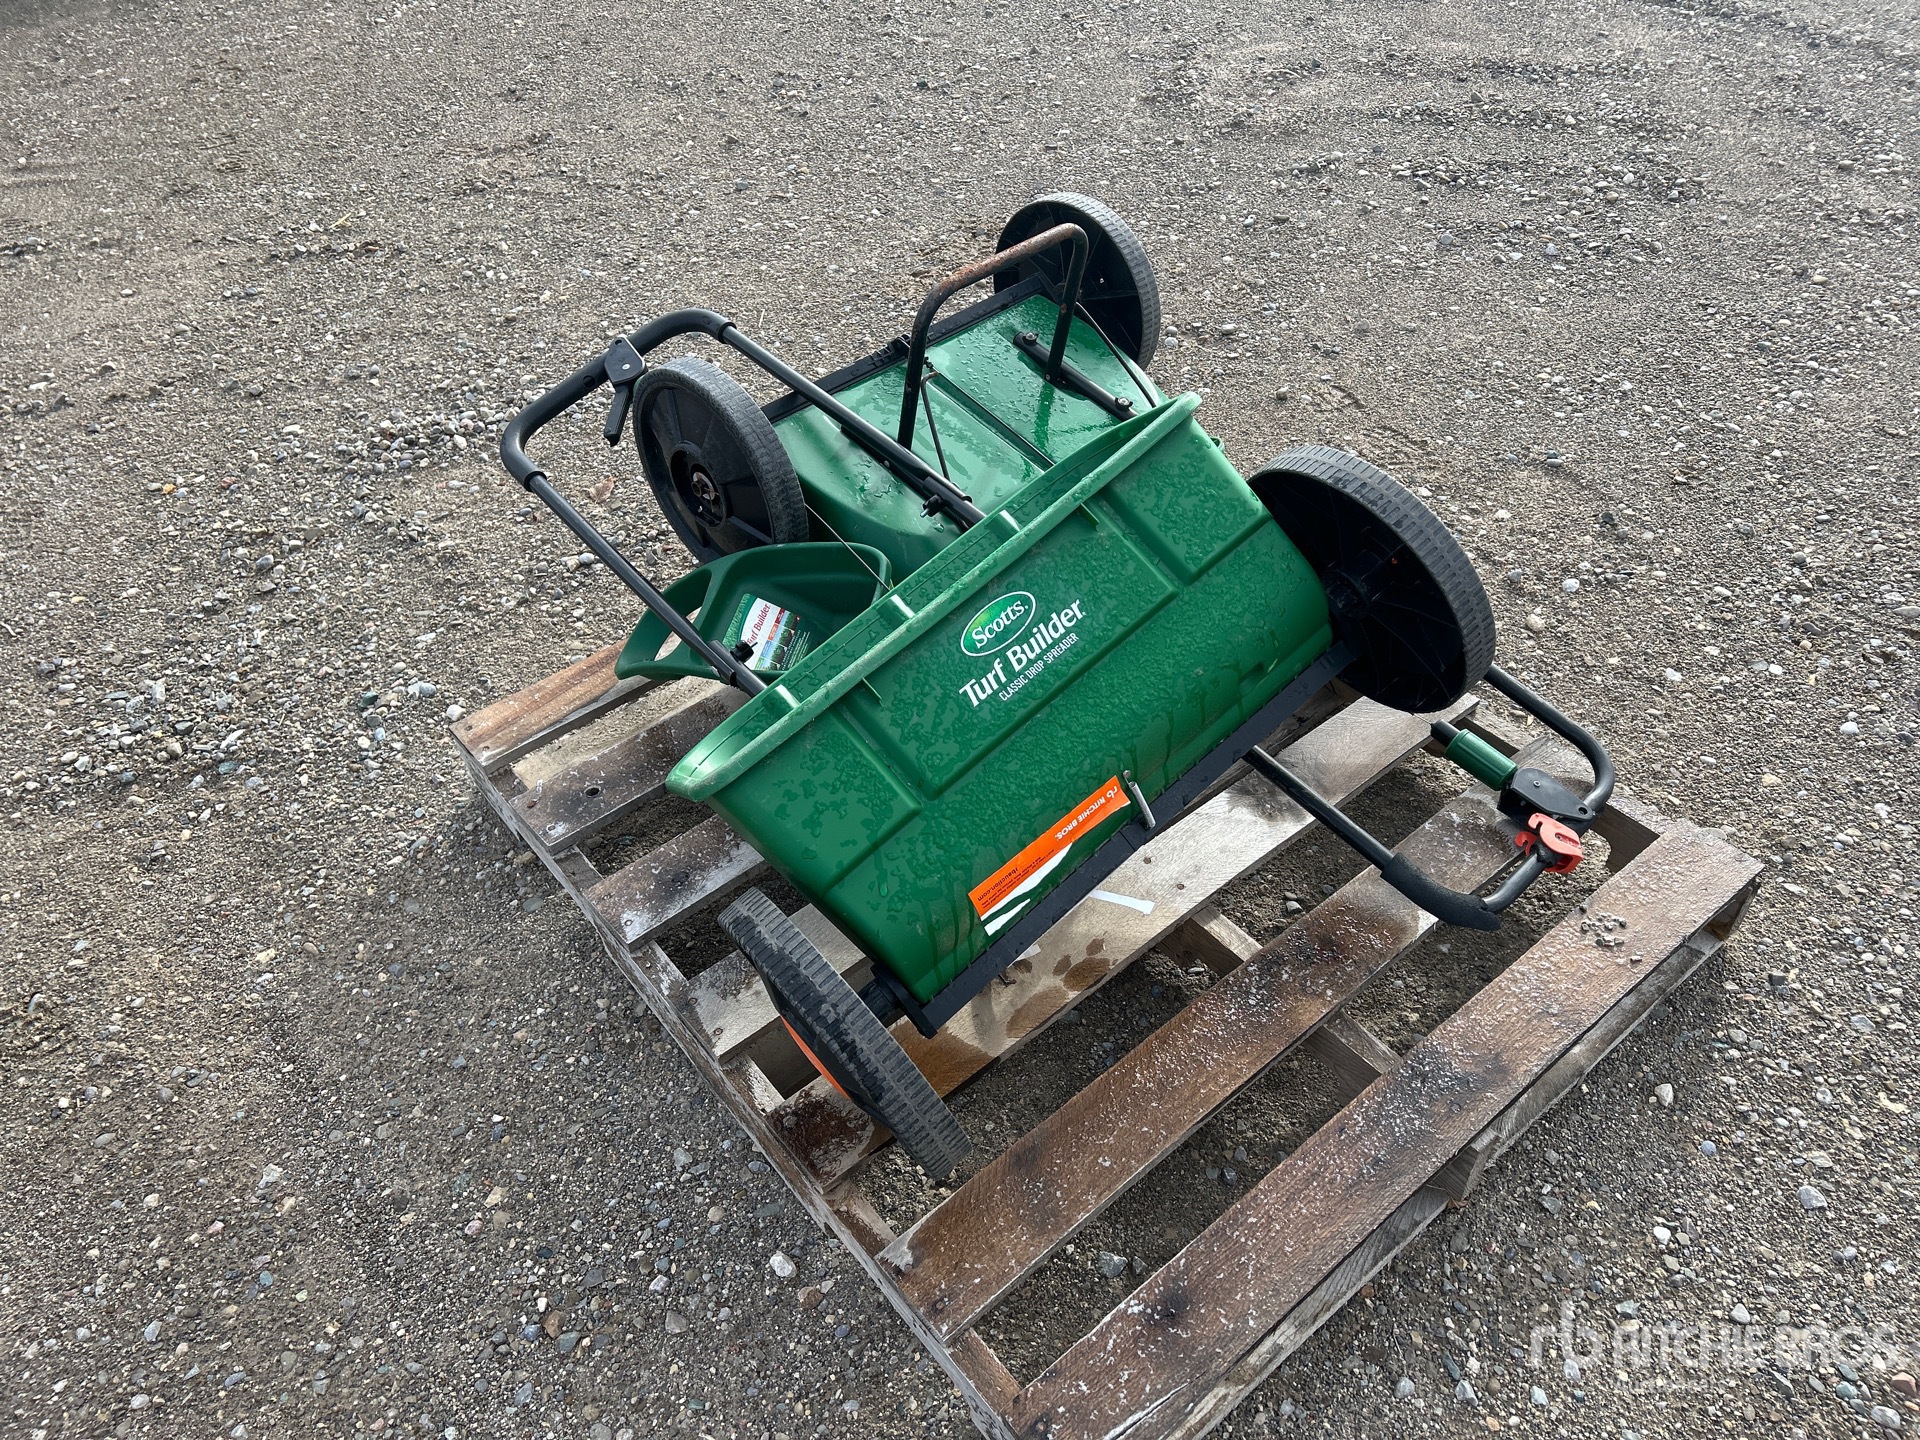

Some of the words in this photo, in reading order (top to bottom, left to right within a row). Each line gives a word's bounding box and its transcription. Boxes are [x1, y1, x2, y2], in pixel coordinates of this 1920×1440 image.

[958, 657, 1007, 708] Turf
[998, 674, 1029, 702] CLASSIC
[1025, 660, 1045, 679] DROP
[1043, 632, 1080, 664] SPREADER
[1077, 796, 1106, 823] RITCHIE
[977, 867, 1019, 902] rbauction.com
